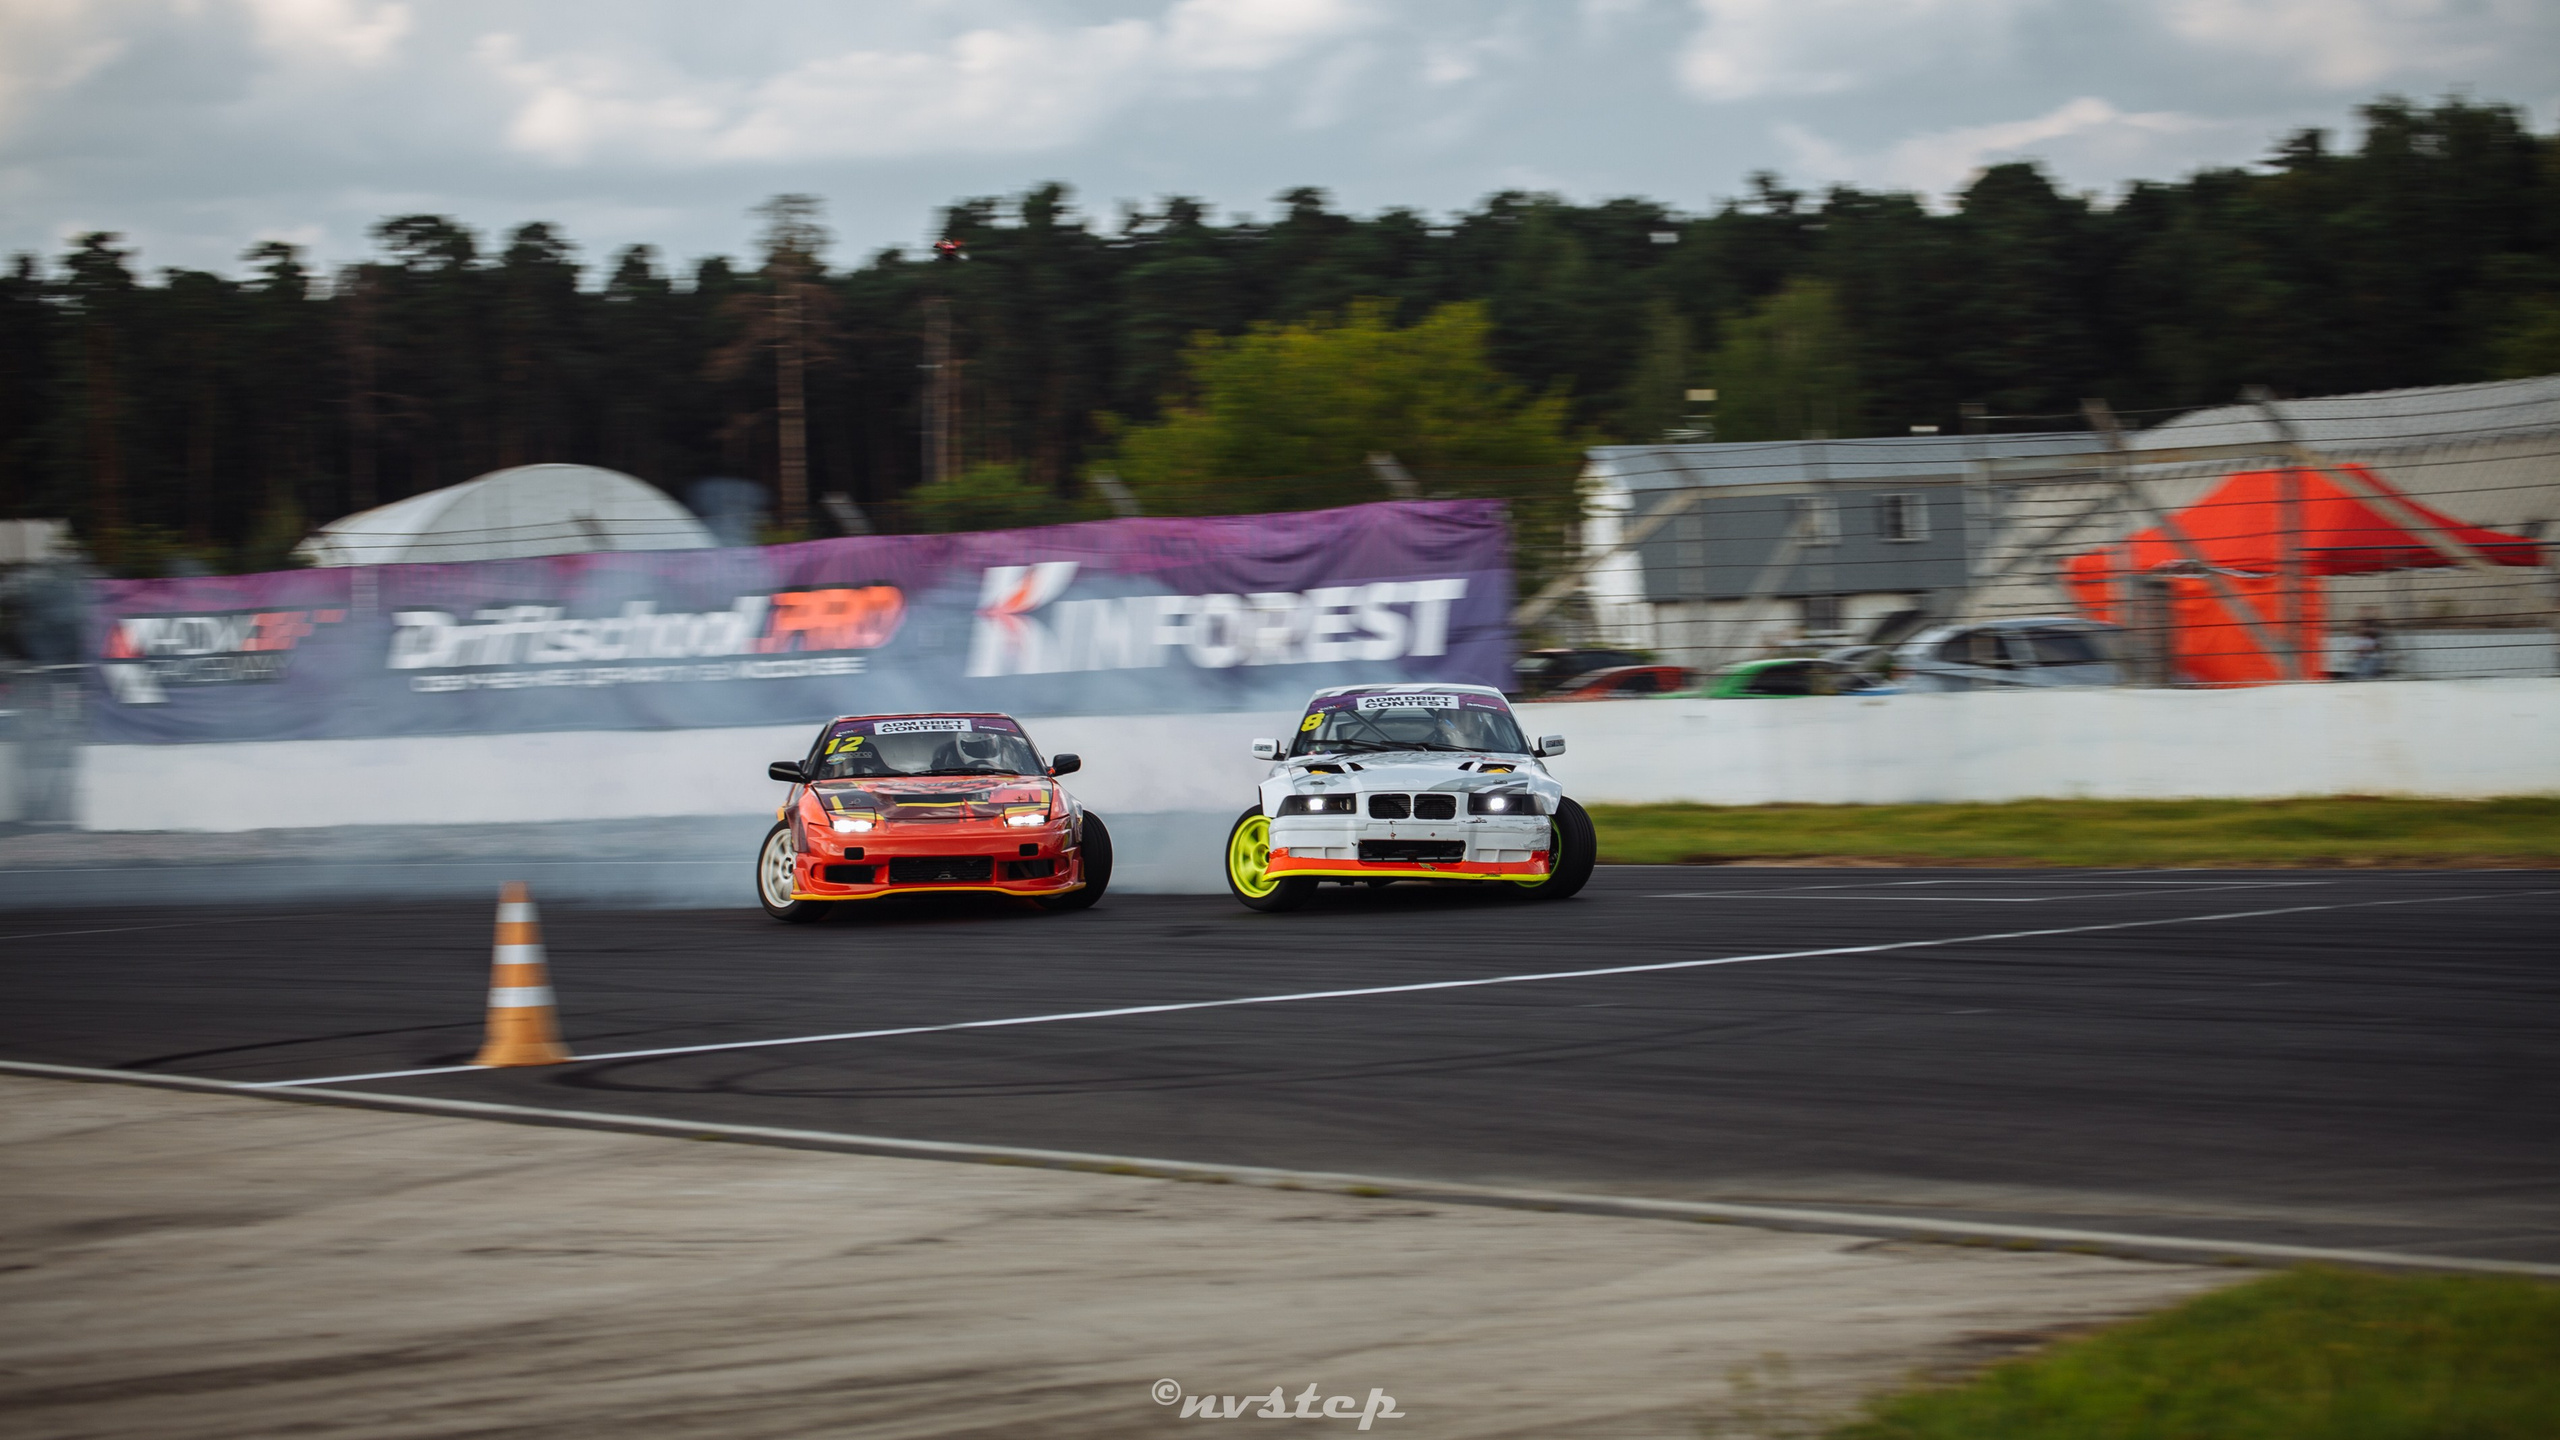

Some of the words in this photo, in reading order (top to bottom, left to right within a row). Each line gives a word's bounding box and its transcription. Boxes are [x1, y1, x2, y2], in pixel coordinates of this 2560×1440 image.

[1365, 701, 1452, 709] CONTEST
[1300, 712, 1326, 732] 8
[882, 725, 965, 733] CONTEST
[824, 736, 865, 755] 12
